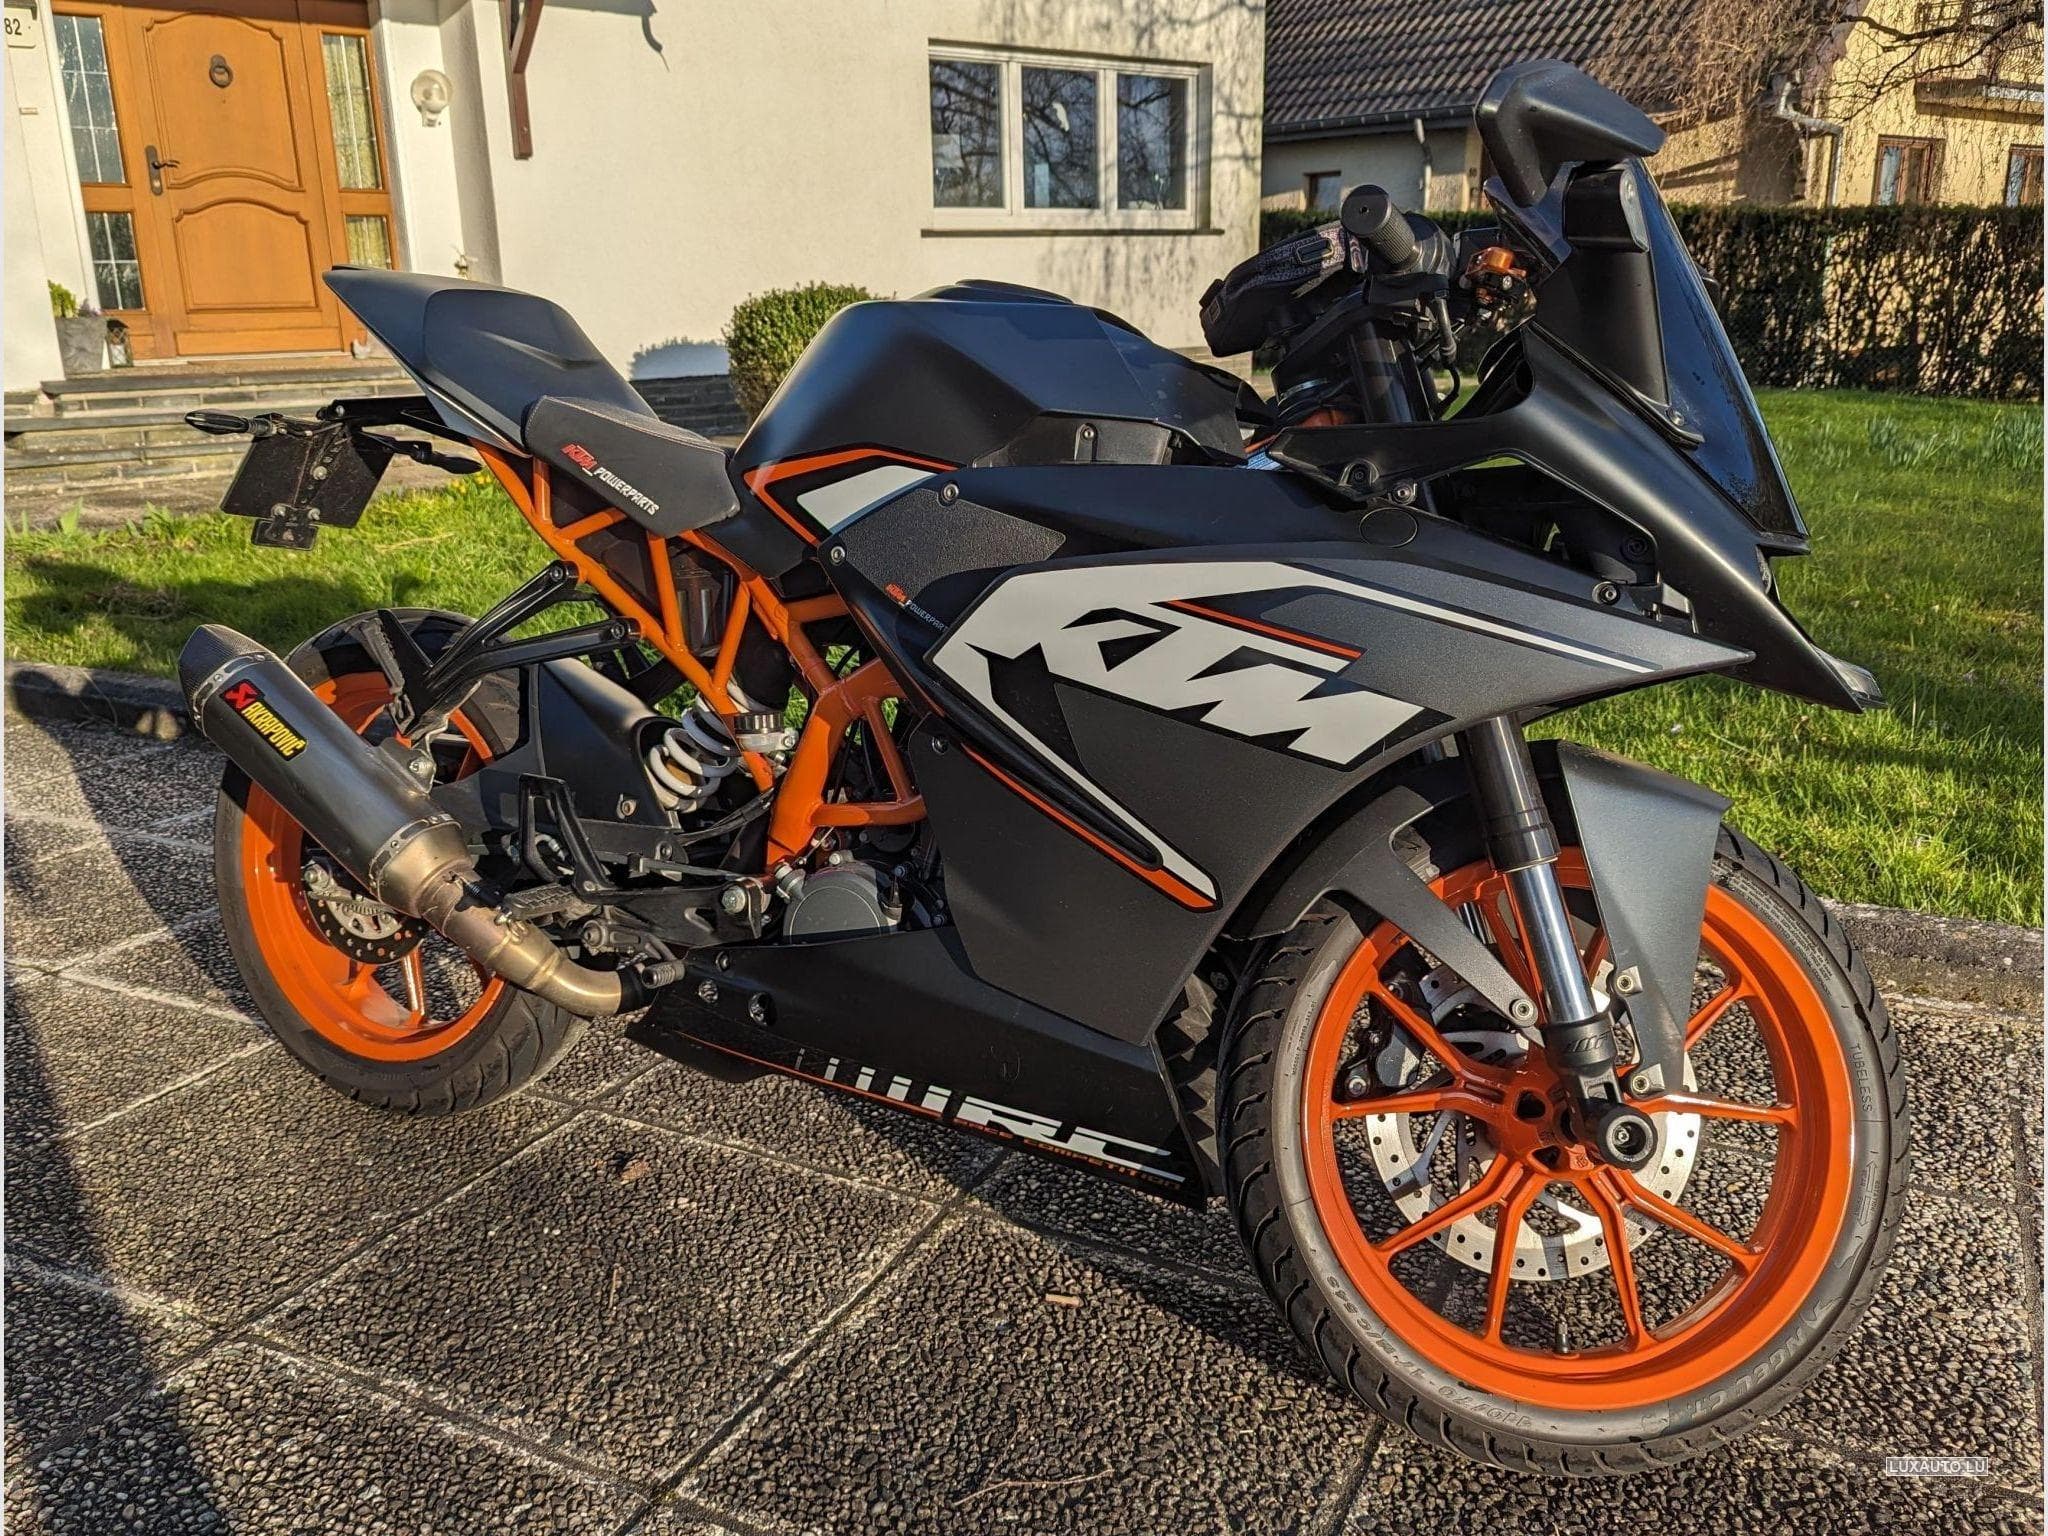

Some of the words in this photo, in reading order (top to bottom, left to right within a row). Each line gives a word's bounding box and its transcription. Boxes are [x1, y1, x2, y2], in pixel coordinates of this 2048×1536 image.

[593, 467, 660, 516] POWERPARTS
[945, 572, 1425, 765] KTM
[1850, 1042, 1873, 1113] TUBELESS
